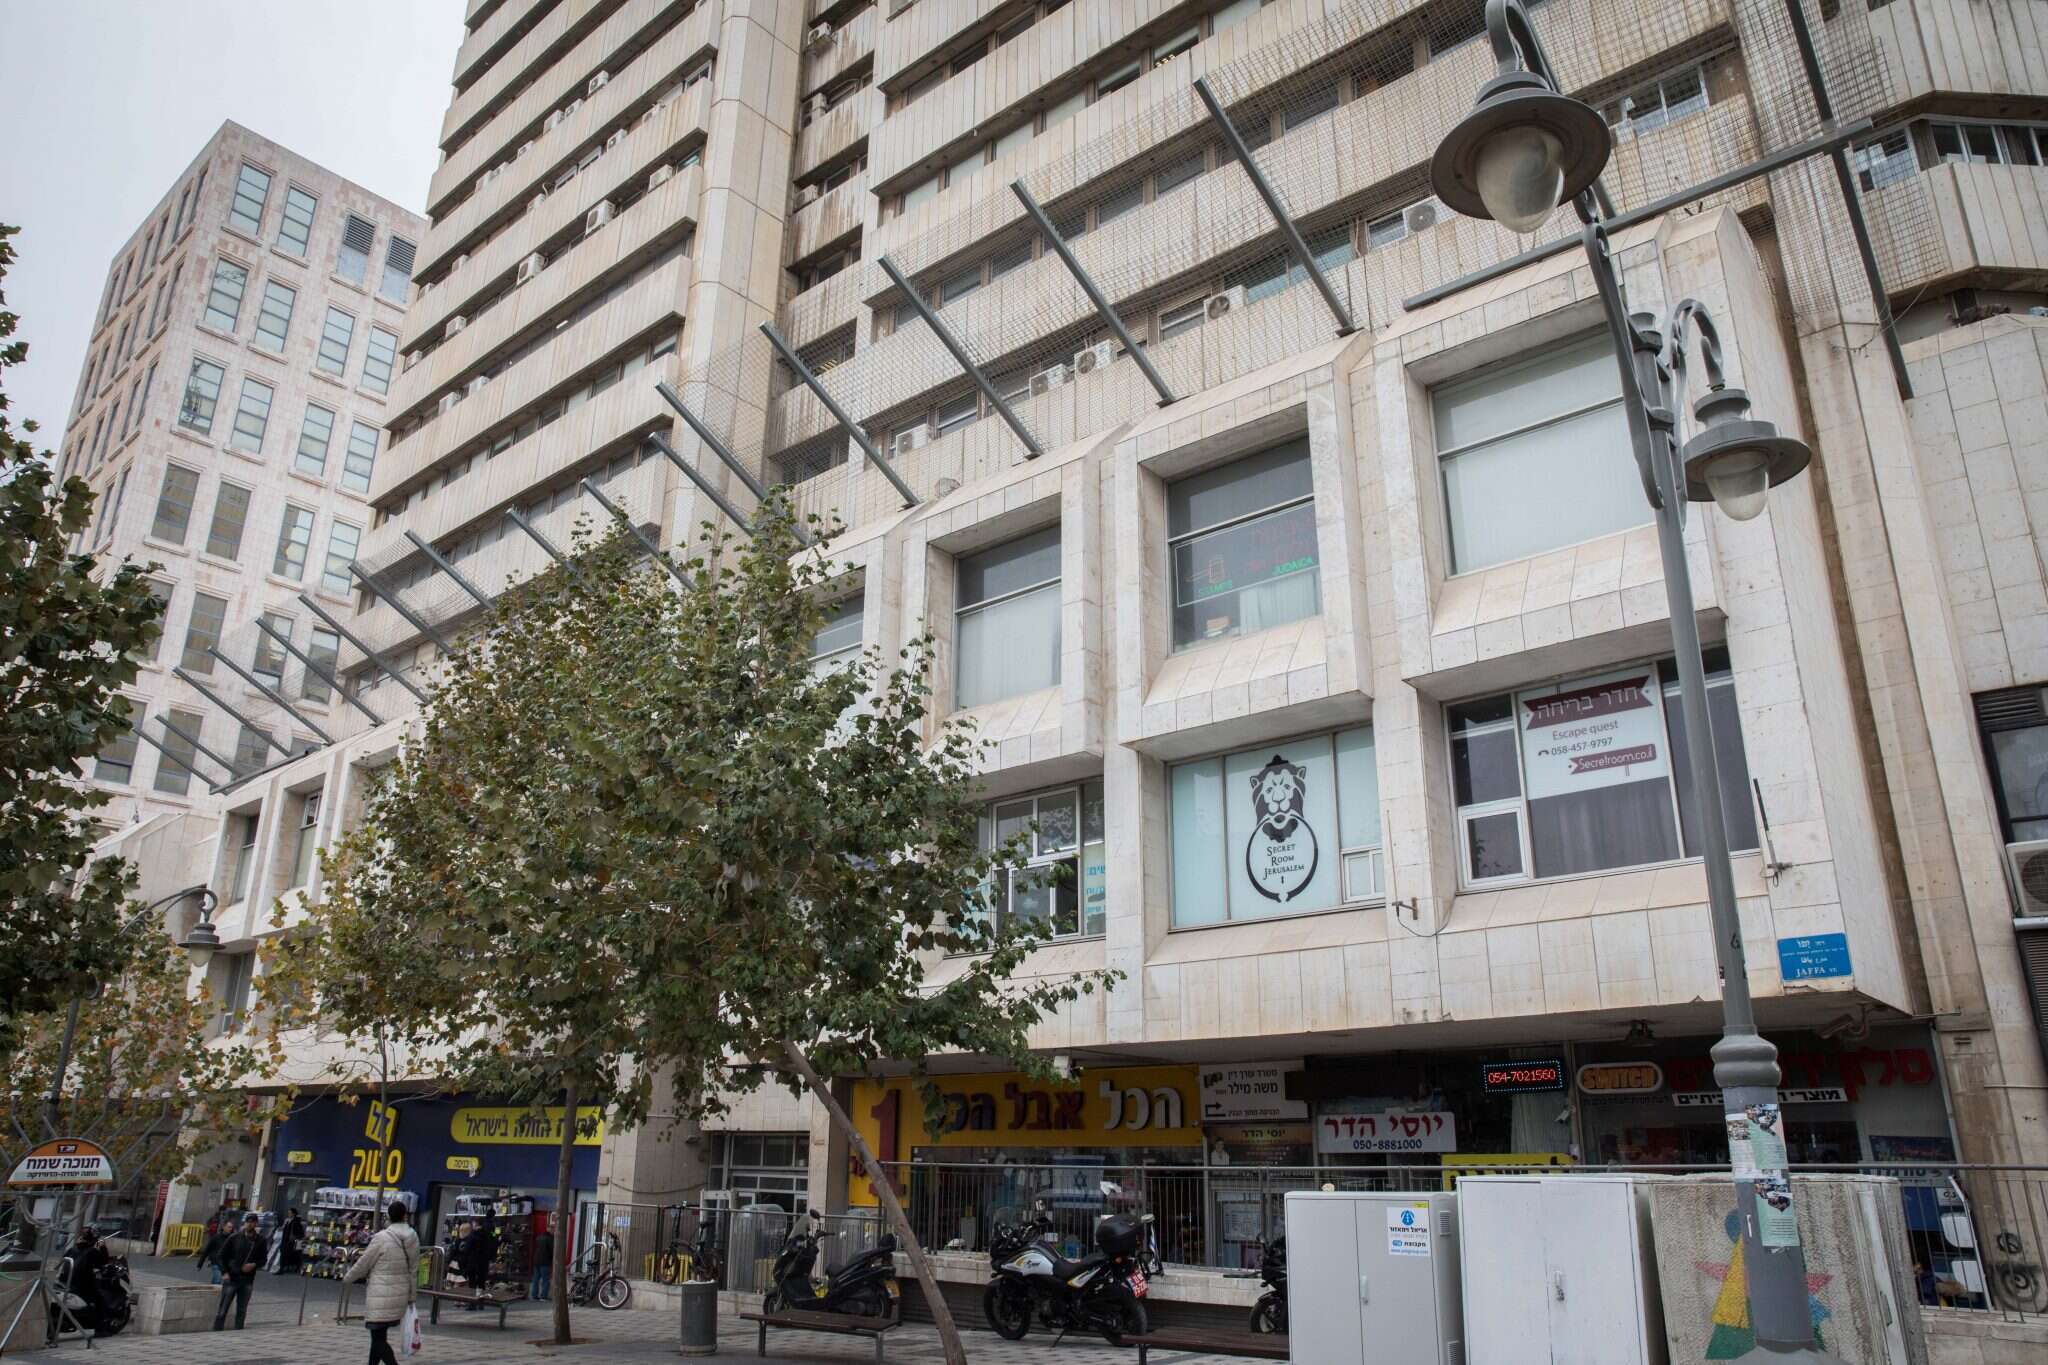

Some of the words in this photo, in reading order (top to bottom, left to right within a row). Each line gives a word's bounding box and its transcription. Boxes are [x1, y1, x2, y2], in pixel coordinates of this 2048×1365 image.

[1599, 687, 1638, 705] חדר
[1537, 696, 1595, 719] בריחה
[1552, 726, 1588, 741] Escape
[1589, 720, 1619, 735] quest
[1551, 737, 1613, 756] 058-457-9797
[1796, 967, 1825, 978] JAFFA
[1227, 1082, 1251, 1095] מילר
[1254, 1082, 1278, 1094] משה
[1789, 1089, 1841, 1102] מוצרי
[1005, 1081, 1086, 1131] אבל
[1100, 1079, 1184, 1131] הכל
[466, 1113, 509, 1137] בישראל
[1324, 1116, 1376, 1139] הדר
[1390, 1114, 1444, 1138] יוסי
[1353, 1139, 1423, 1150] 050-8881000
[26, 1157, 61, 1170] שמח
[63, 1157, 100, 1169] חנוכה
